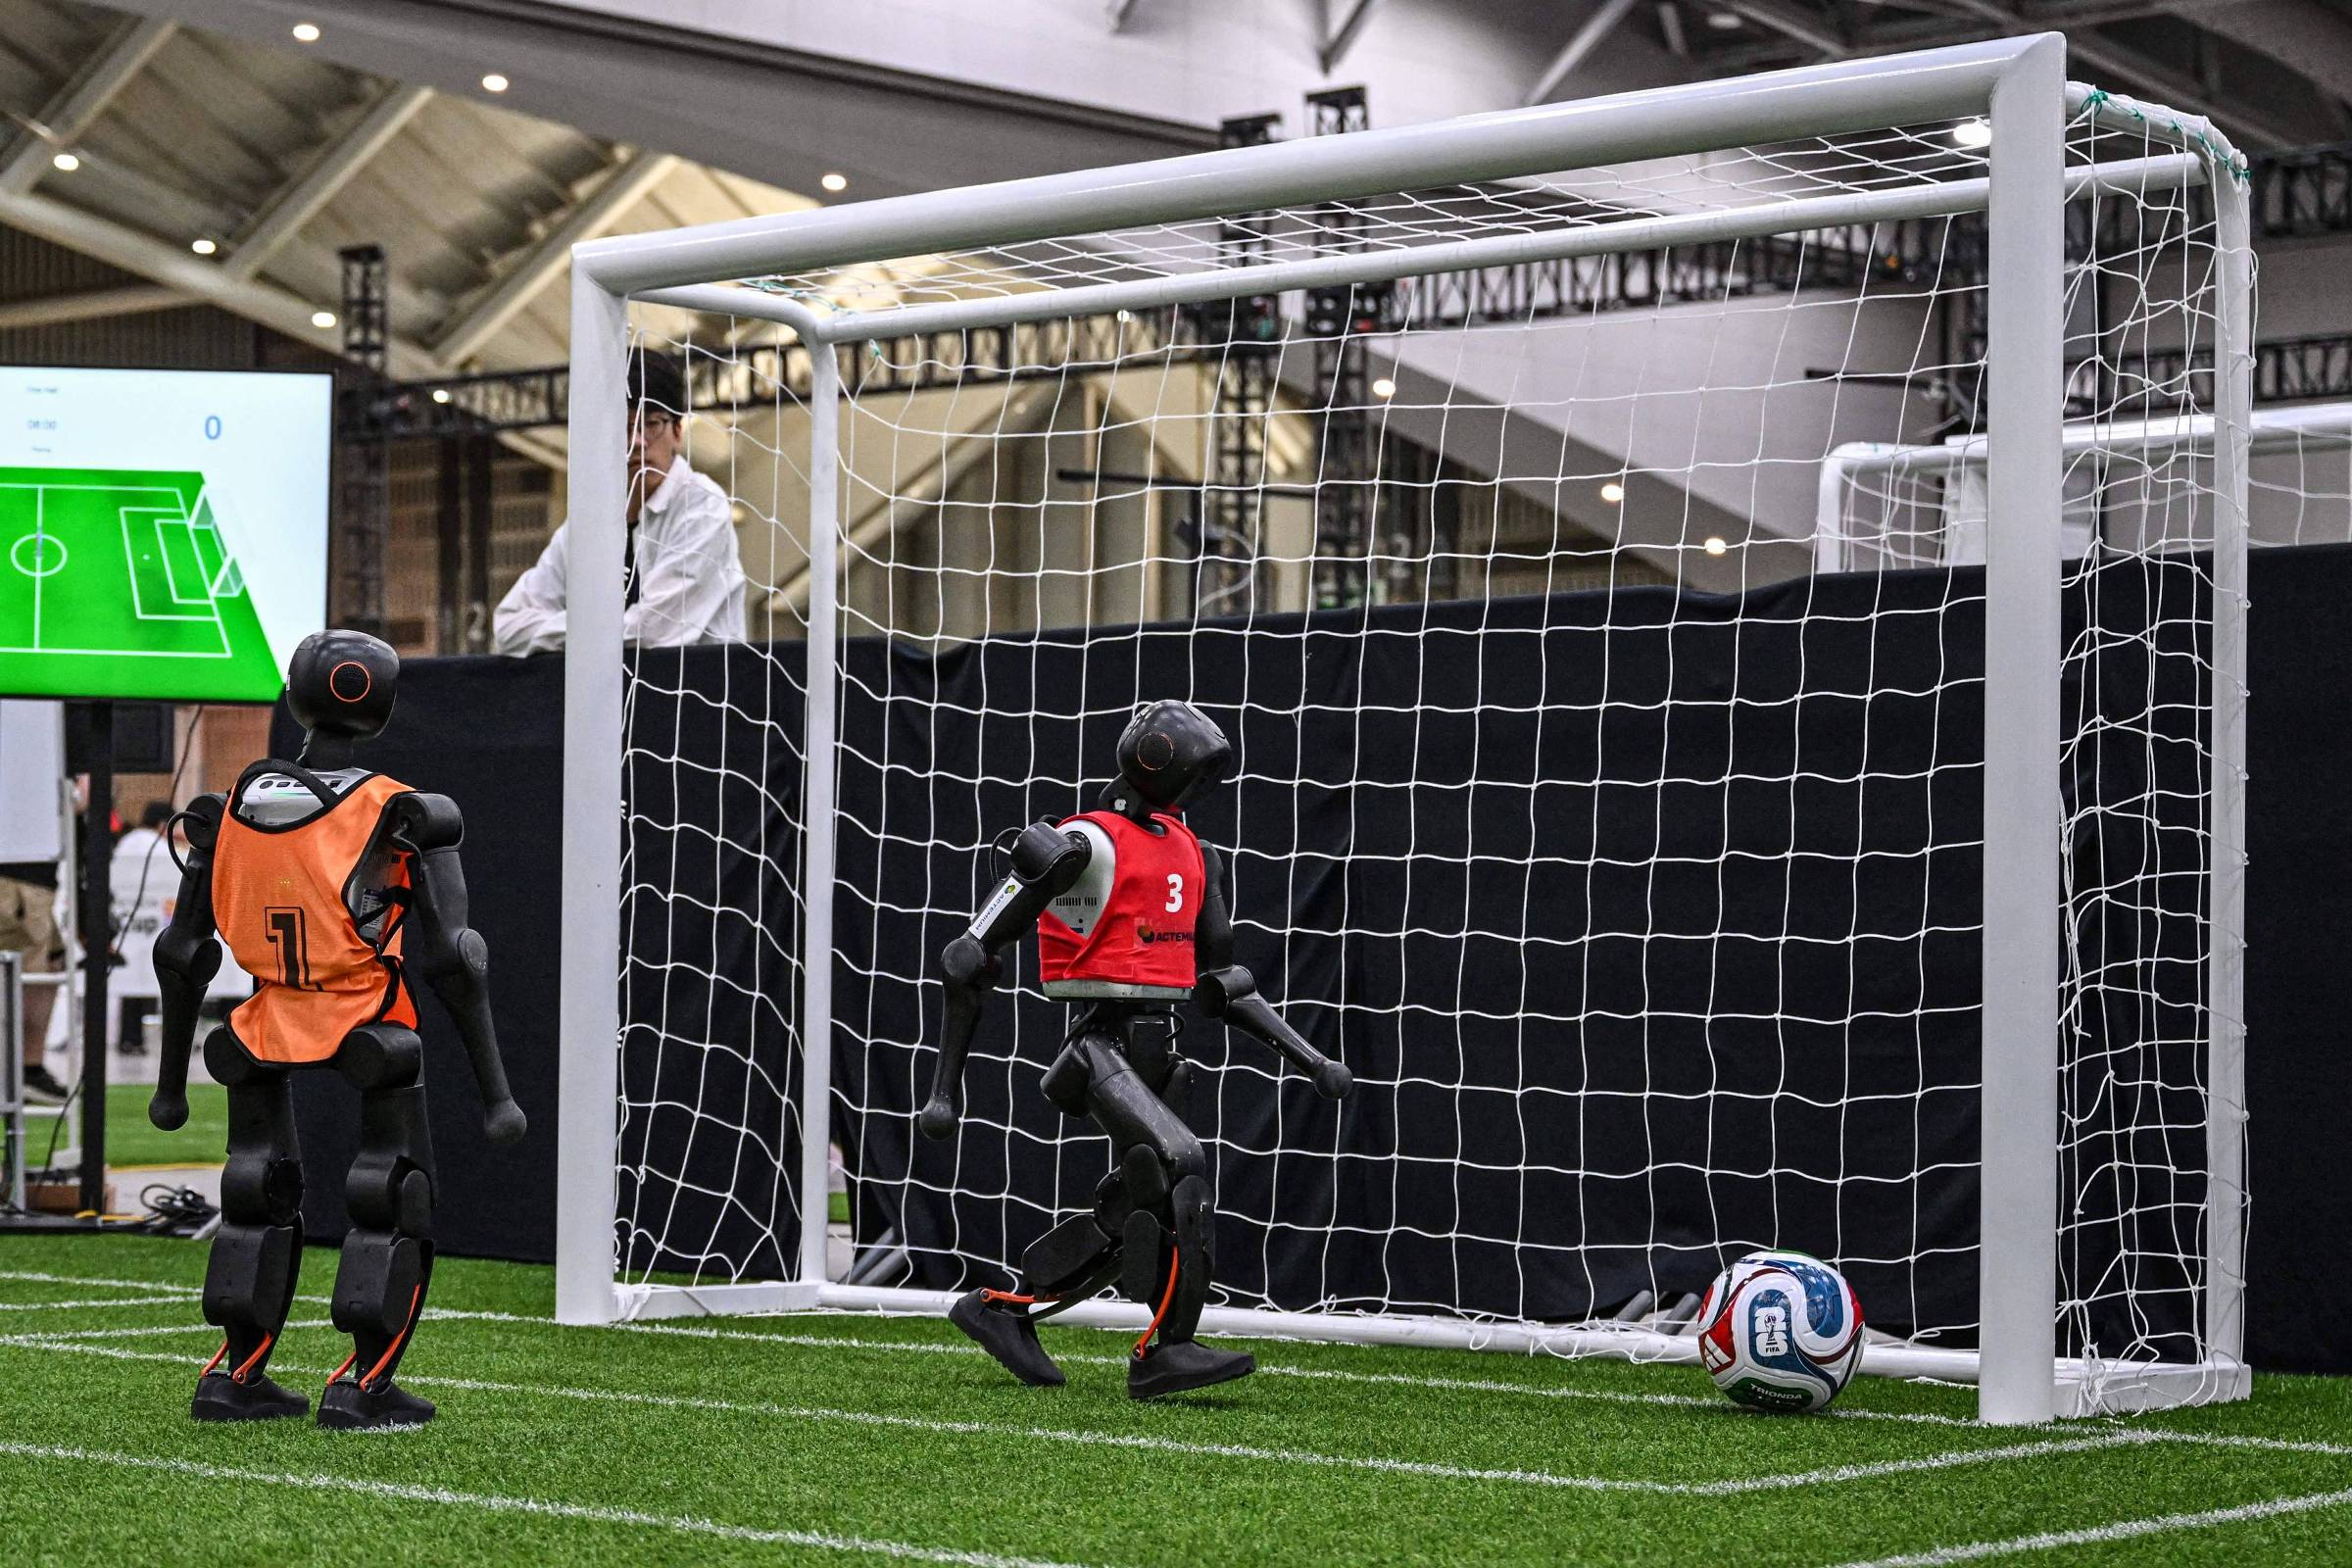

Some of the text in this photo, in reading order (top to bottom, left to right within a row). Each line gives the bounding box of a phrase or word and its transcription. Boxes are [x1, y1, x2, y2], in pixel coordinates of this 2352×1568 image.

[205, 416, 221, 440] 0
[1165, 873, 1183, 912] 3
[975, 893, 1004, 931] ACTEMIUM
[264, 906, 324, 993] 1
[1750, 1383, 1803, 1399] TRIONDA
